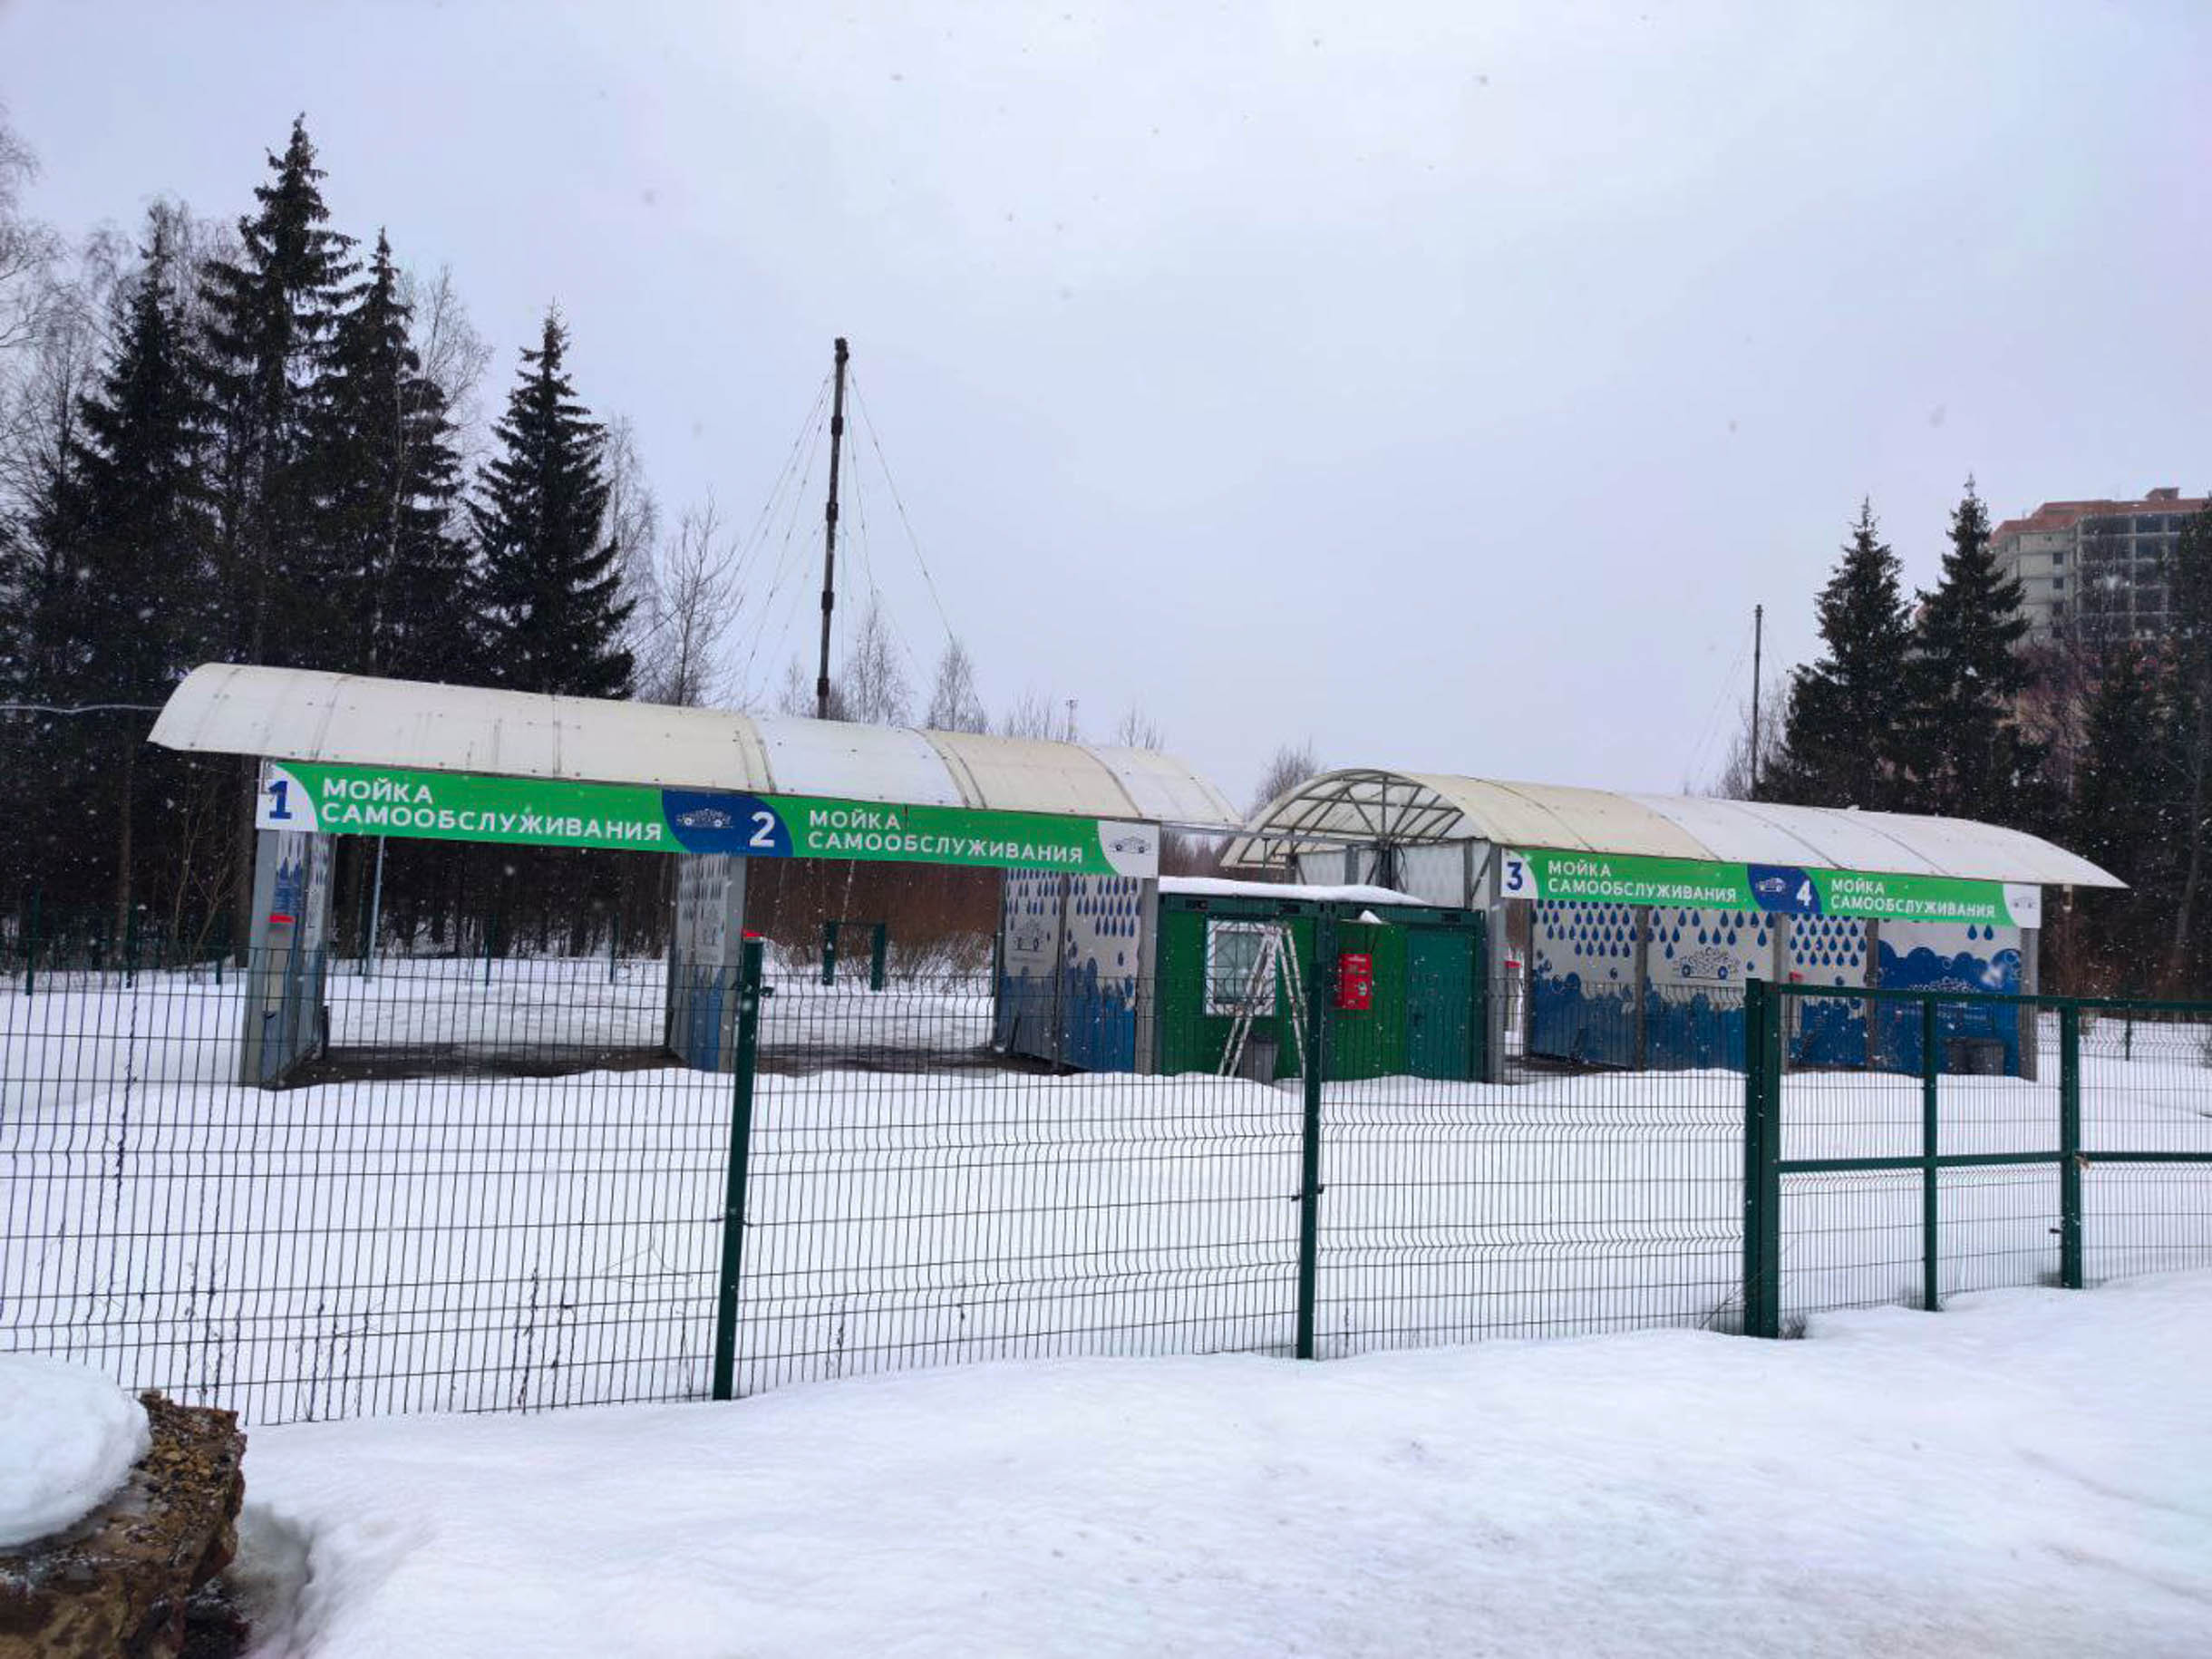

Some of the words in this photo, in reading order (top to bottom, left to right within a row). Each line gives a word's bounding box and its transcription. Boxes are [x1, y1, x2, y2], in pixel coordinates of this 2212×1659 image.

[267, 780, 293, 820] 1
[322, 777, 434, 805] МОЙКА
[320, 802, 663, 841] САМООБСЛУЖИВАНИЯ
[749, 810, 776, 848] 2
[808, 808, 902, 831] МОЙКА
[808, 830, 1083, 864] САМООБСЛУЖИВАНИЯ
[1506, 861, 1524, 891] 3
[1547, 859, 1612, 878] МОЙКА
[1547, 878, 1737, 902] САМООБСЛУЖИВАНИЯ
[1796, 879, 1812, 907] 4
[1830, 877, 1886, 894] МОЙКА
[1830, 894, 1996, 918] САМООБСЛУЖИВАНИЯ
